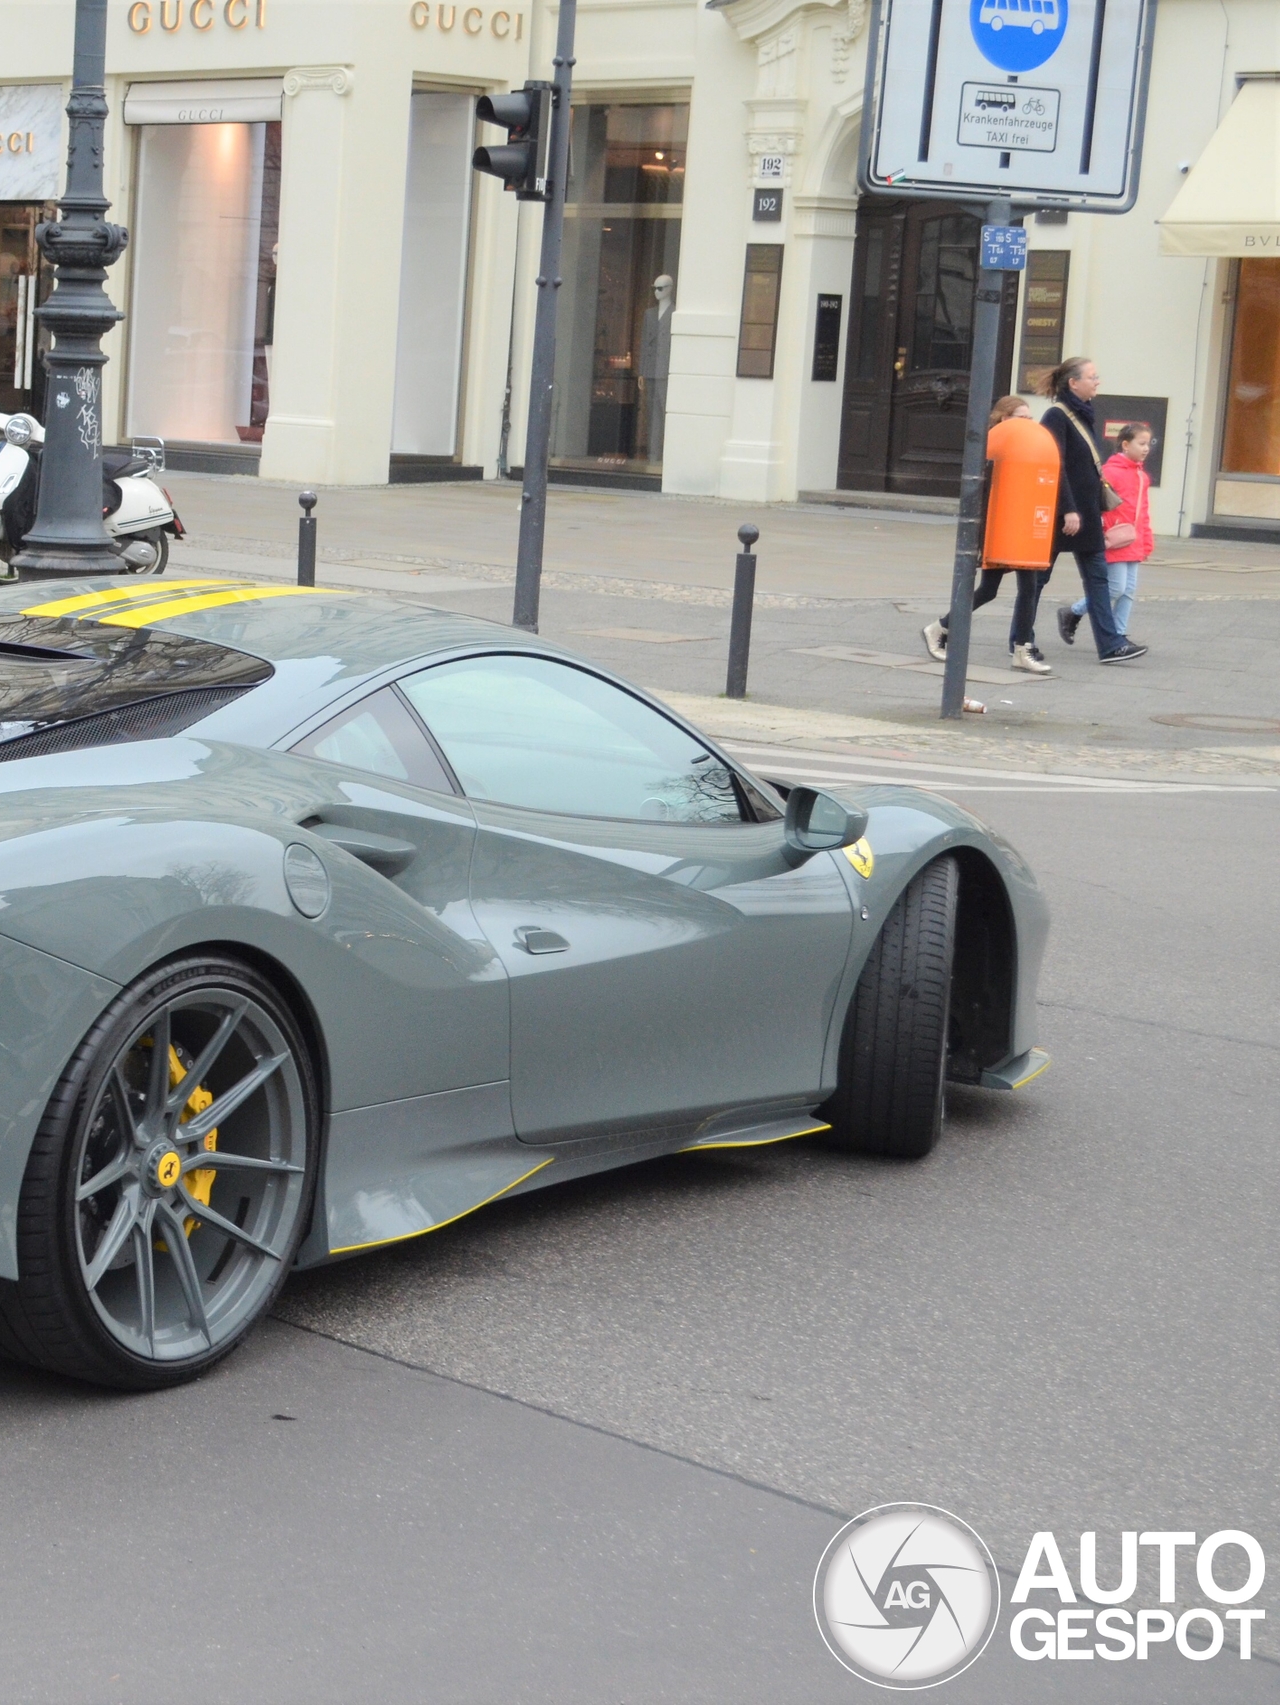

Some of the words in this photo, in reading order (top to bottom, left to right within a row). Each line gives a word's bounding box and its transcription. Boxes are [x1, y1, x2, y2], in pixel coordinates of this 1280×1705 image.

[127, 0, 266, 34] GUCCI
[410, 1, 523, 40] GUCCI
[178, 109, 224, 121] GUCCI
[963, 113, 1053, 132] Krankenfahrzeuge
[986, 131, 1008, 143] TAXI
[1012, 134, 1029, 145] frei
[761, 157, 782, 170] 192
[758, 198, 776, 211] 192
